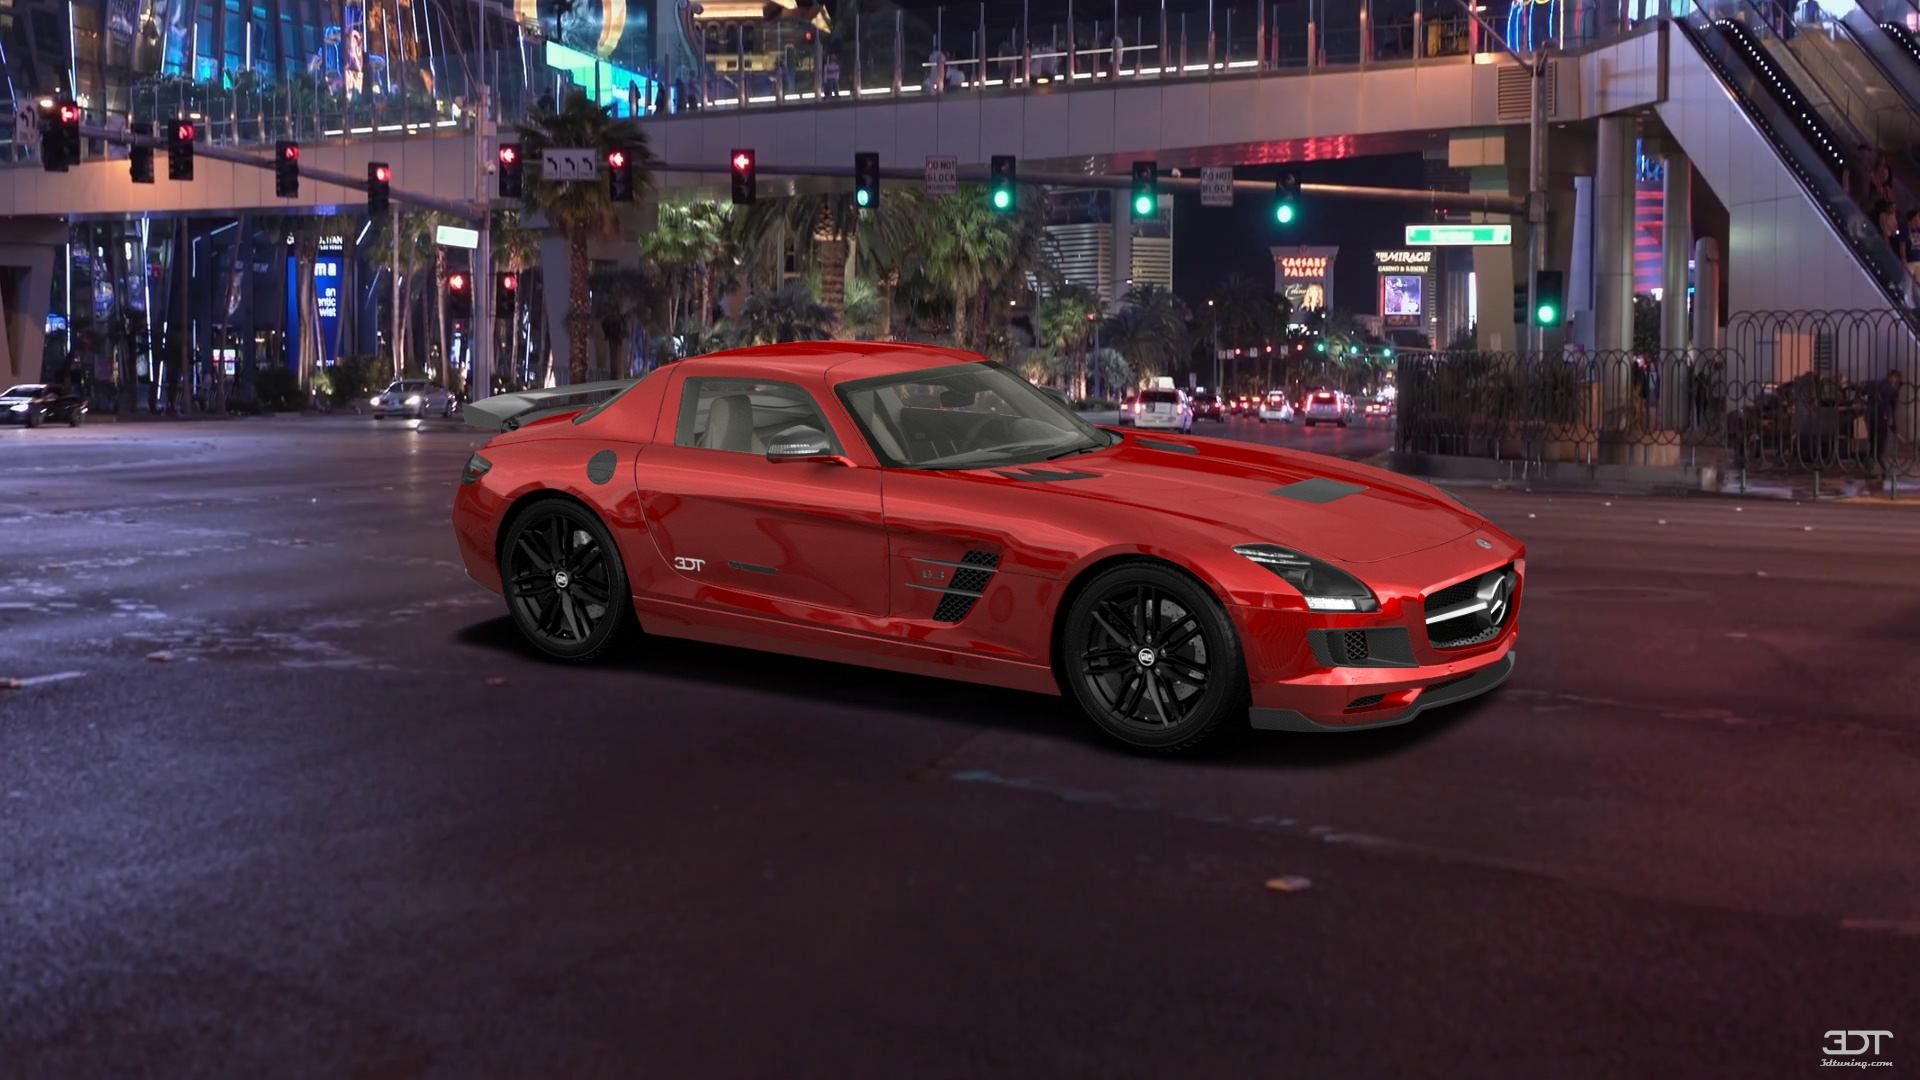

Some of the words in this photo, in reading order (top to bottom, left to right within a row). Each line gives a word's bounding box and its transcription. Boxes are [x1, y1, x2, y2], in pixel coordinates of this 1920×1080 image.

[1282, 257, 1326, 268] CAESARS
[1385, 251, 1431, 263] MIRAGE
[1284, 267, 1324, 277] PALACE
[674, 556, 706, 572] 3DT
